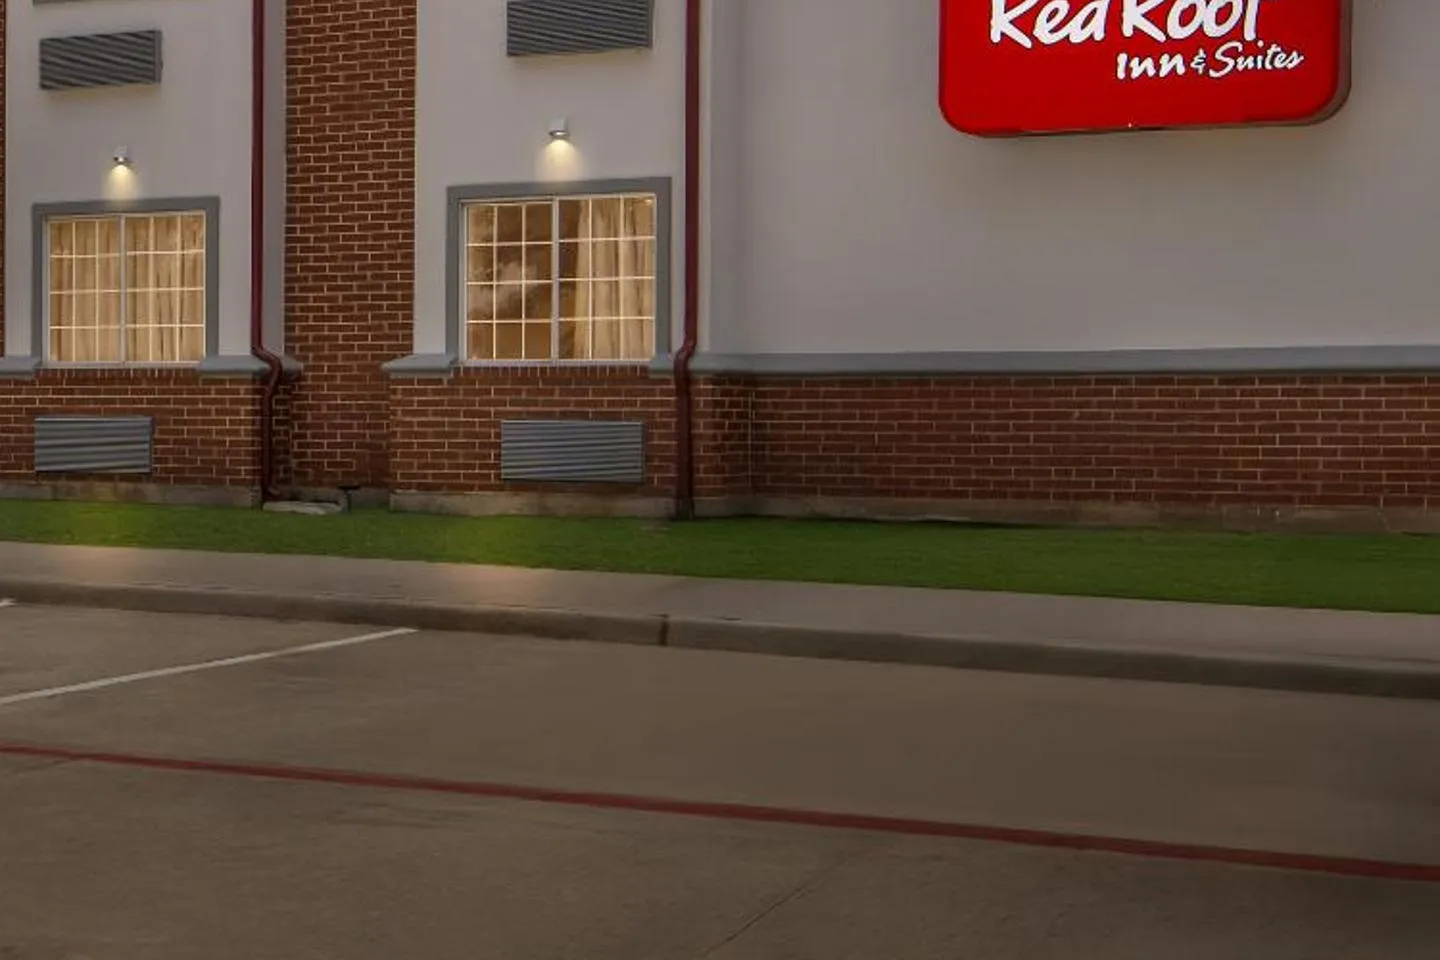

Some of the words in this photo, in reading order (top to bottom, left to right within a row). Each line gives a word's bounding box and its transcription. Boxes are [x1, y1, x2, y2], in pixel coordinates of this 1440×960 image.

[1116, 52, 1186, 80] Inn
[1190, 48, 1207, 74] &
[1208, 40, 1305, 78] Suites
